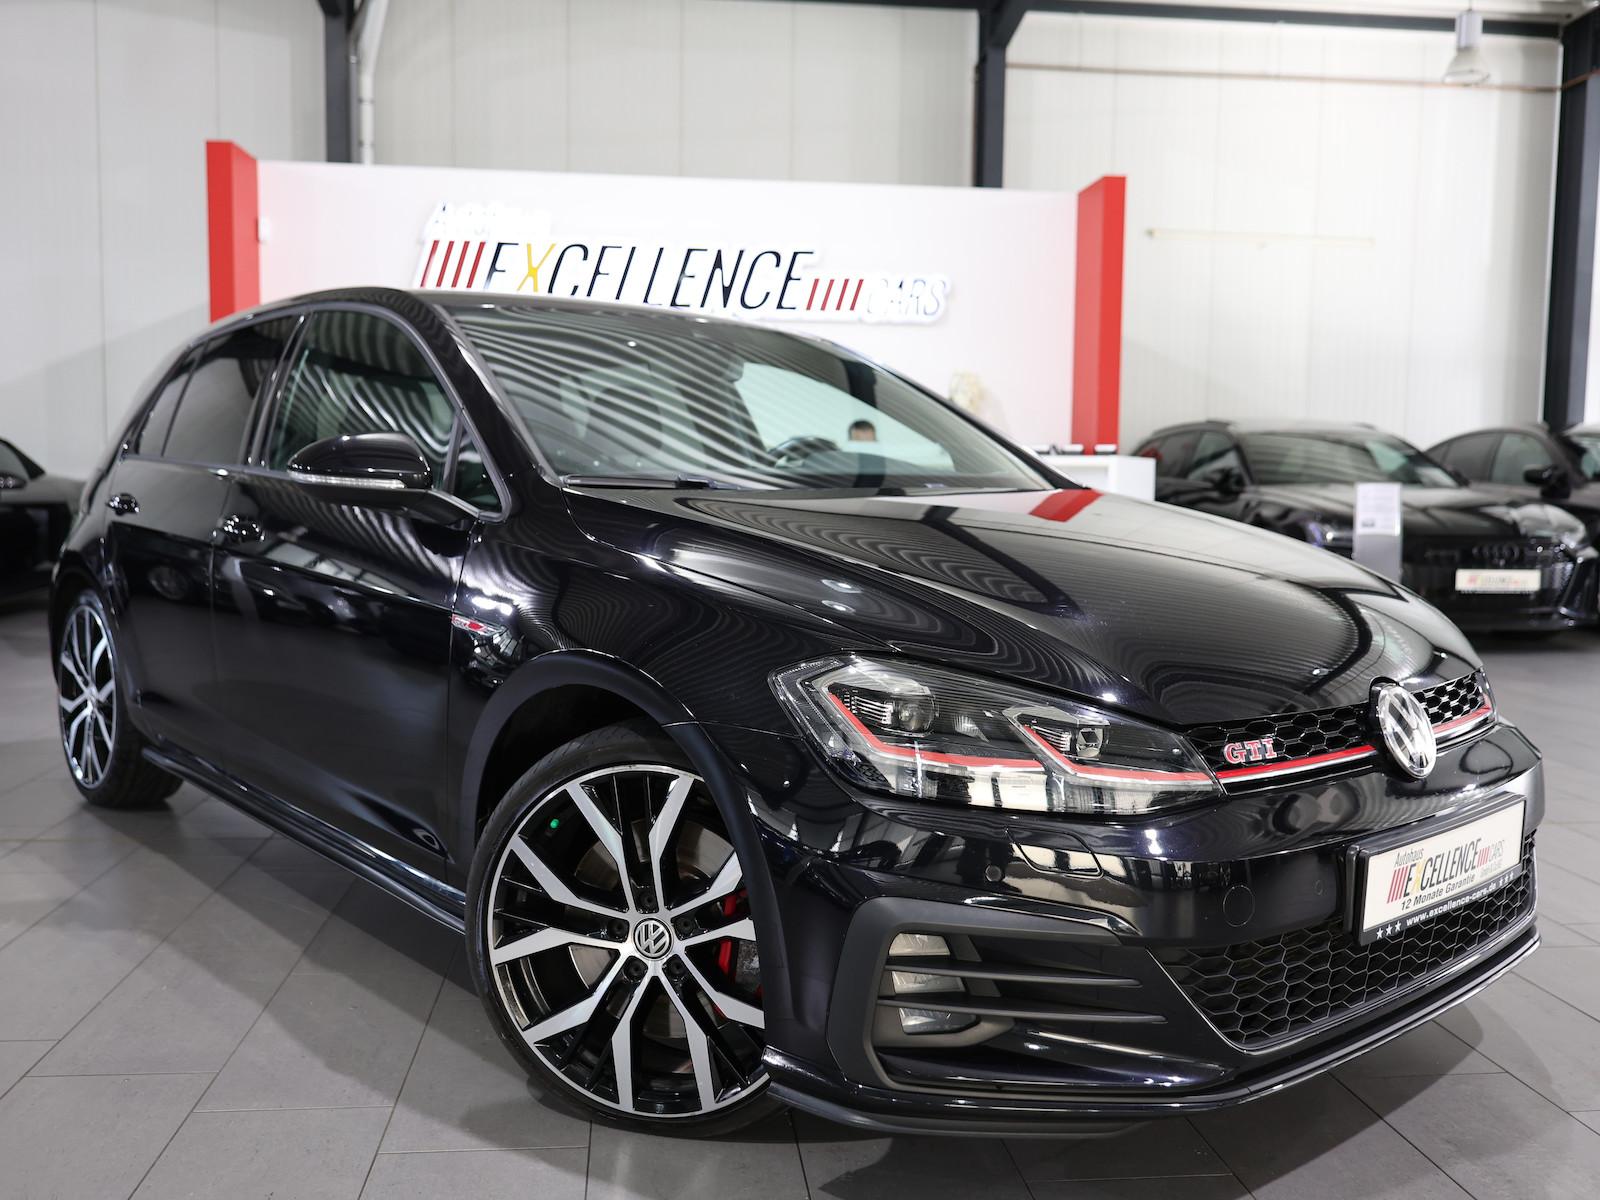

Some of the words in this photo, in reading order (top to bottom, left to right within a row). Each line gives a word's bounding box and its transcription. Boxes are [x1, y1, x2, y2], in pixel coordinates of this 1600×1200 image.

[1224, 737, 1278, 764] GTI
[1393, 848, 1425, 868] Autohaus
[1403, 838, 1482, 898] EXCELLENCE
[1401, 897, 1412, 911] 12
[1413, 888, 1444, 907] Monate
[1445, 874, 1476, 894] Garantie
[1406, 881, 1497, 927] www.excellence-cars.de
